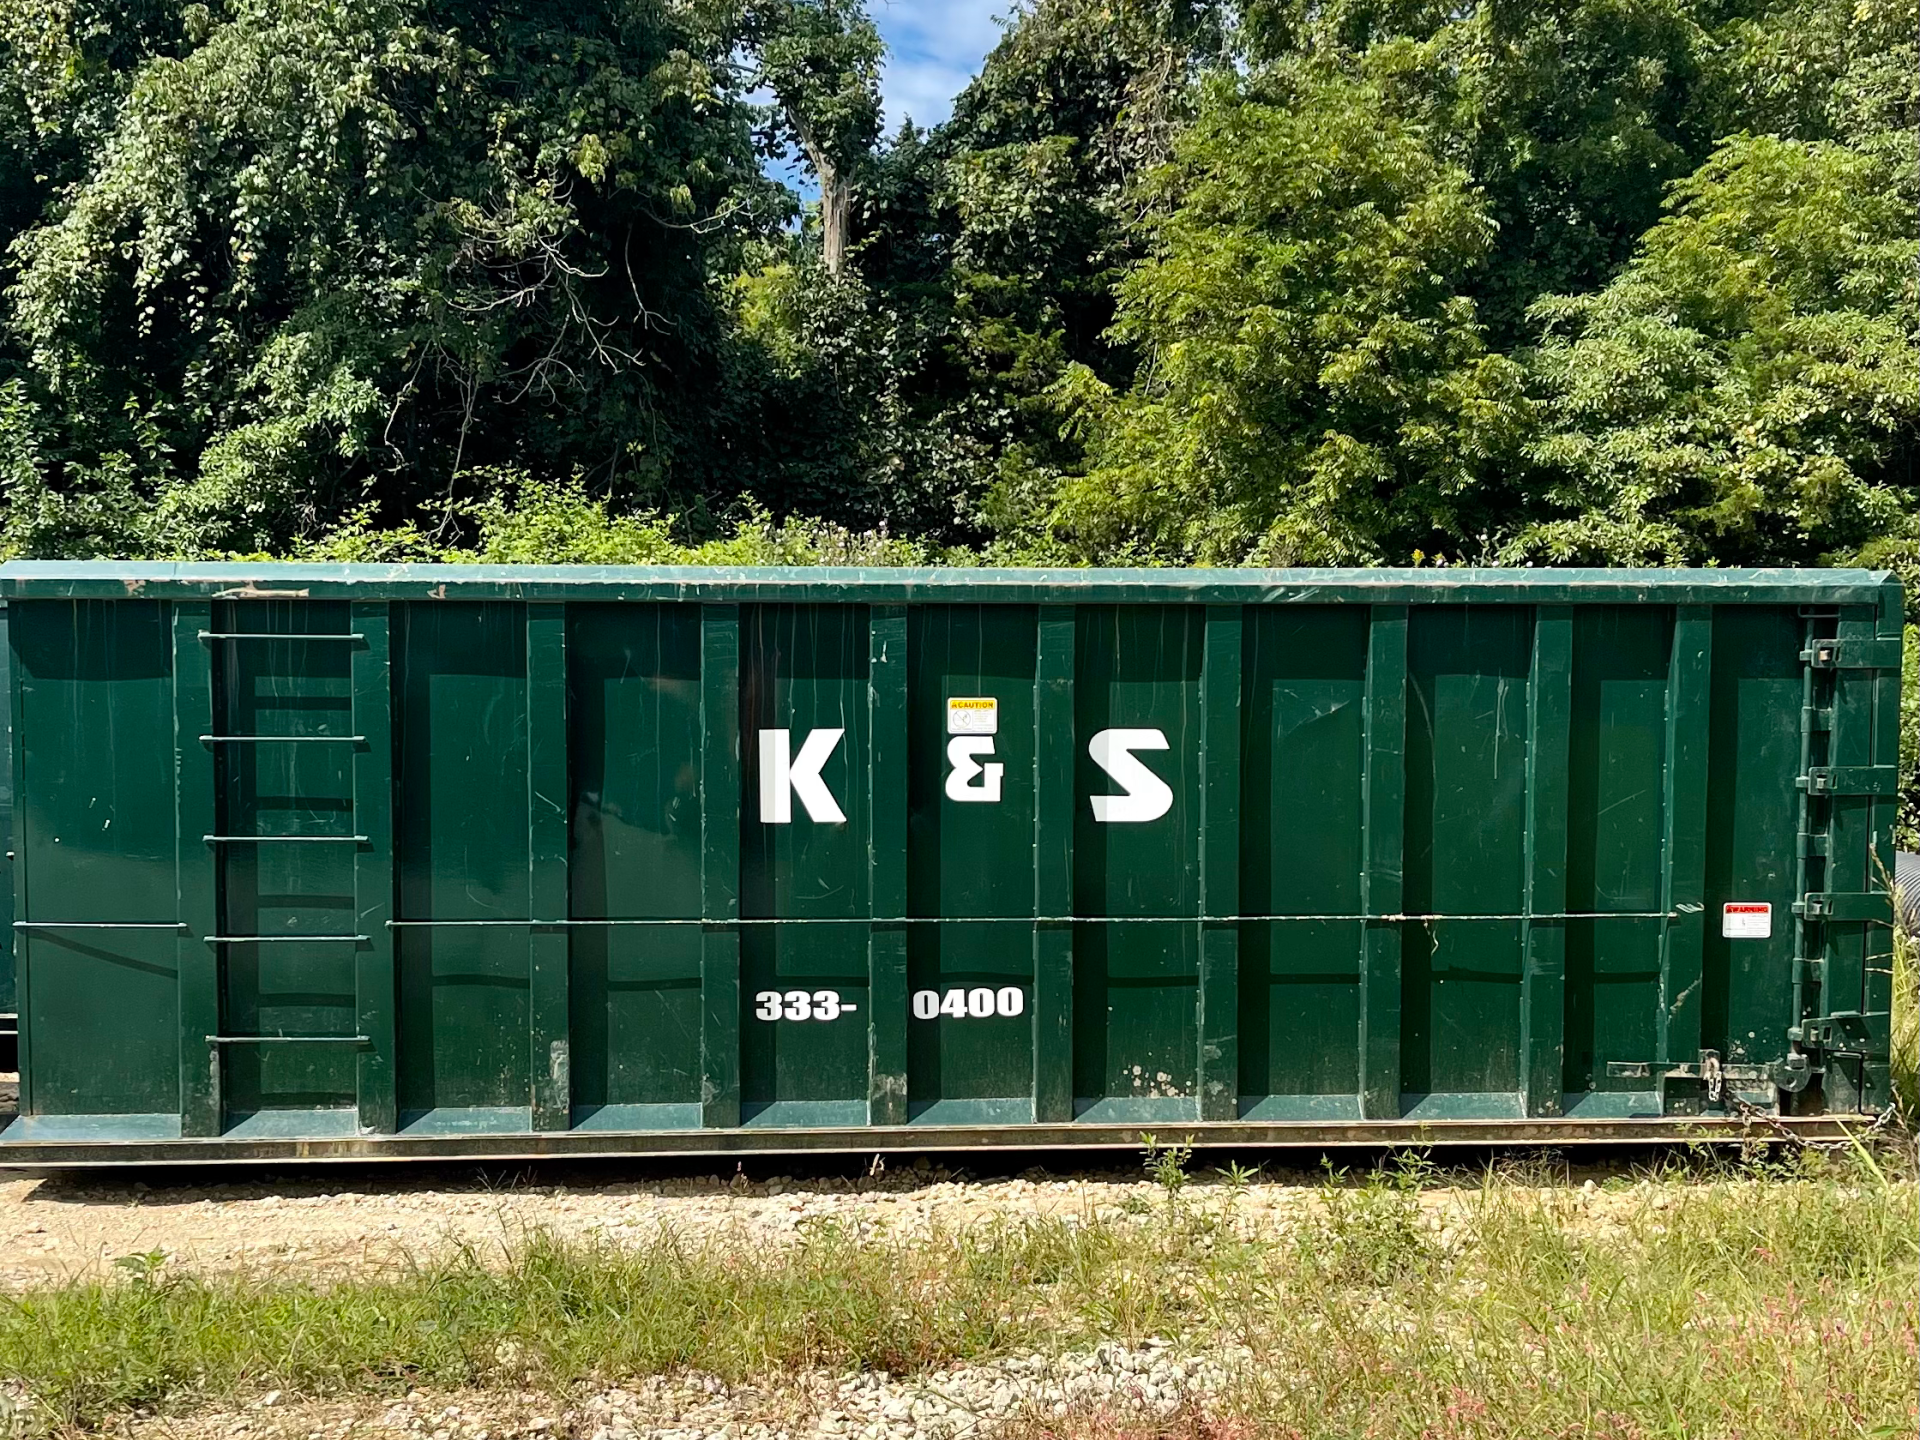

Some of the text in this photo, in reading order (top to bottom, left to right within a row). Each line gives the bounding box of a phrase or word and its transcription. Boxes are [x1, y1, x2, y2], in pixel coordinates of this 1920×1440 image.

[957, 701, 994, 709] CAUTION
[759, 728, 1174, 824] K & S
[913, 986, 1024, 1020] 0400
